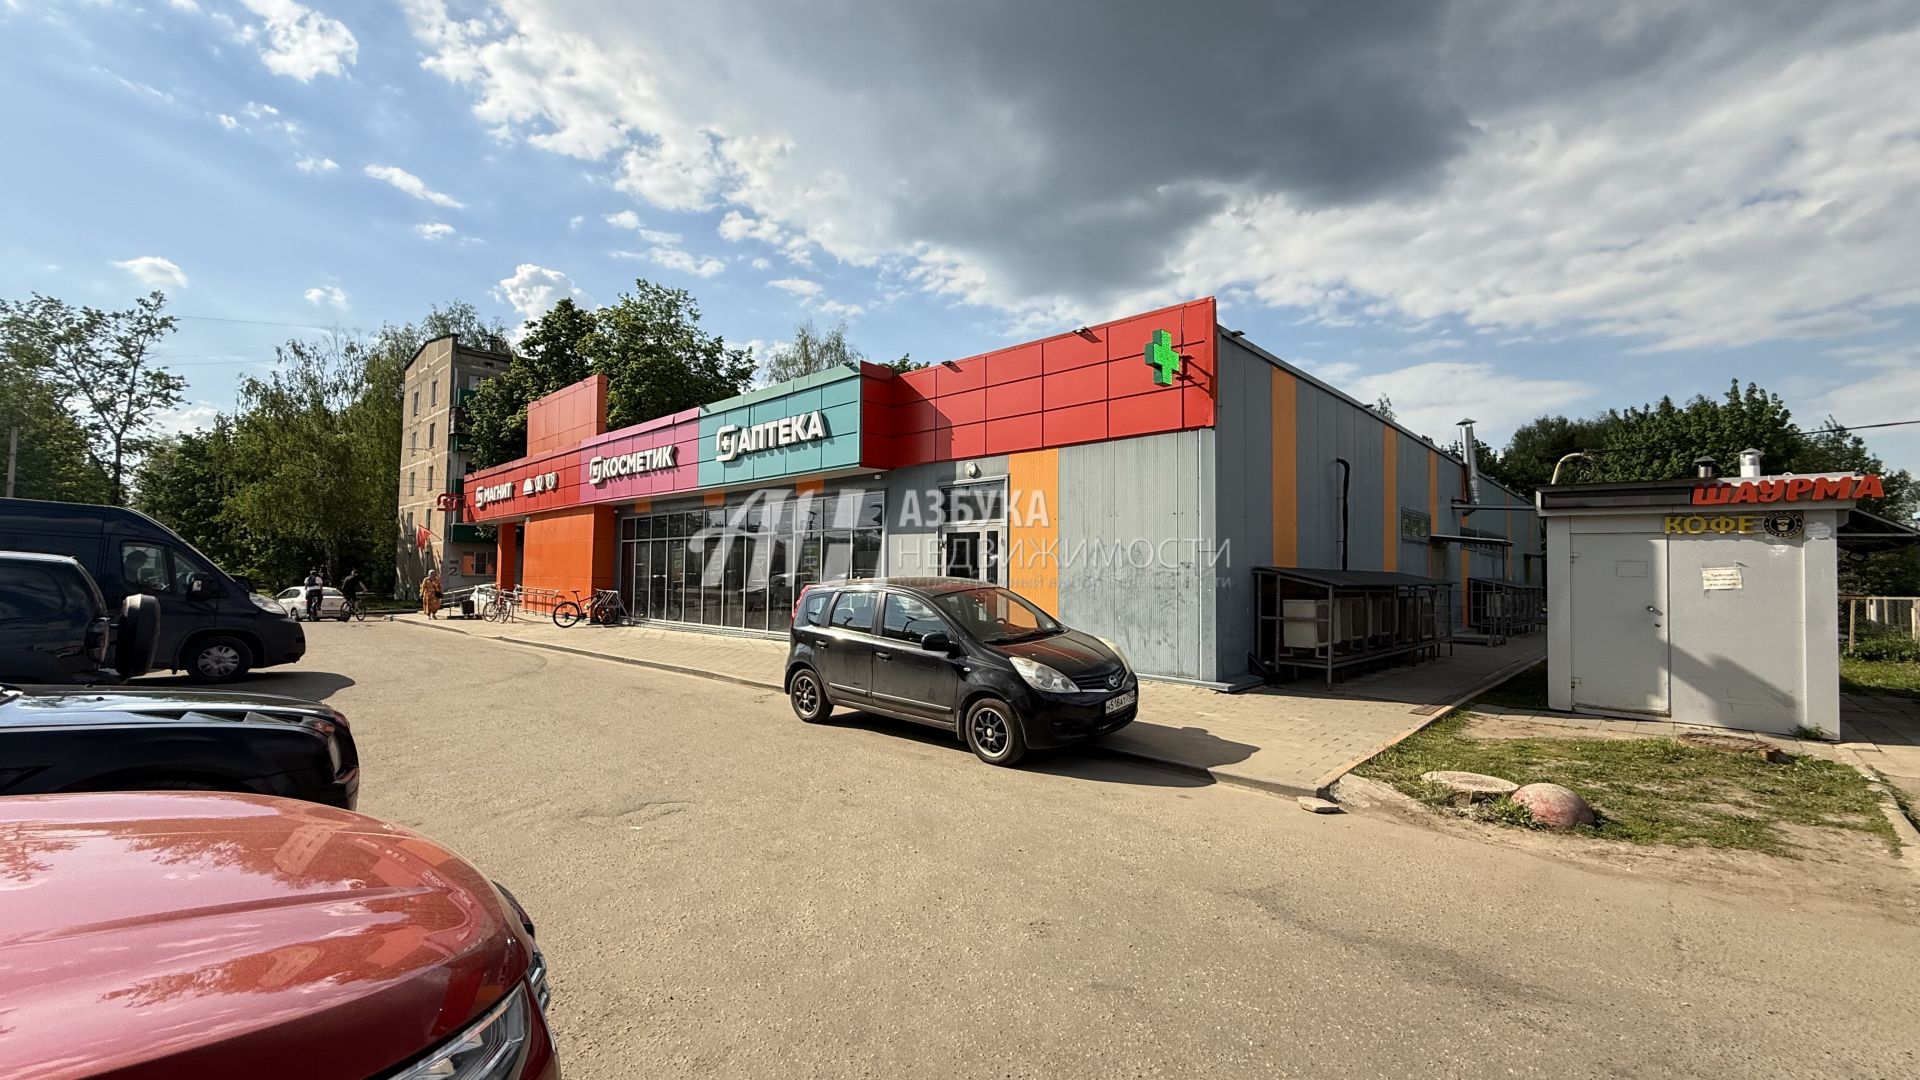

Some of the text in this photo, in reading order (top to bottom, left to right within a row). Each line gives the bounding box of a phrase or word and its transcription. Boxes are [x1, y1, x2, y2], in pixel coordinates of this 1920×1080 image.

[737, 411, 827, 453] АПТЕКА
[602, 445, 677, 478] КОСМЕТИК
[483, 482, 515, 504] МАГНИТ
[1692, 474, 1885, 506] ШАУРМА
[1664, 514, 1754, 535] КОФЕ
